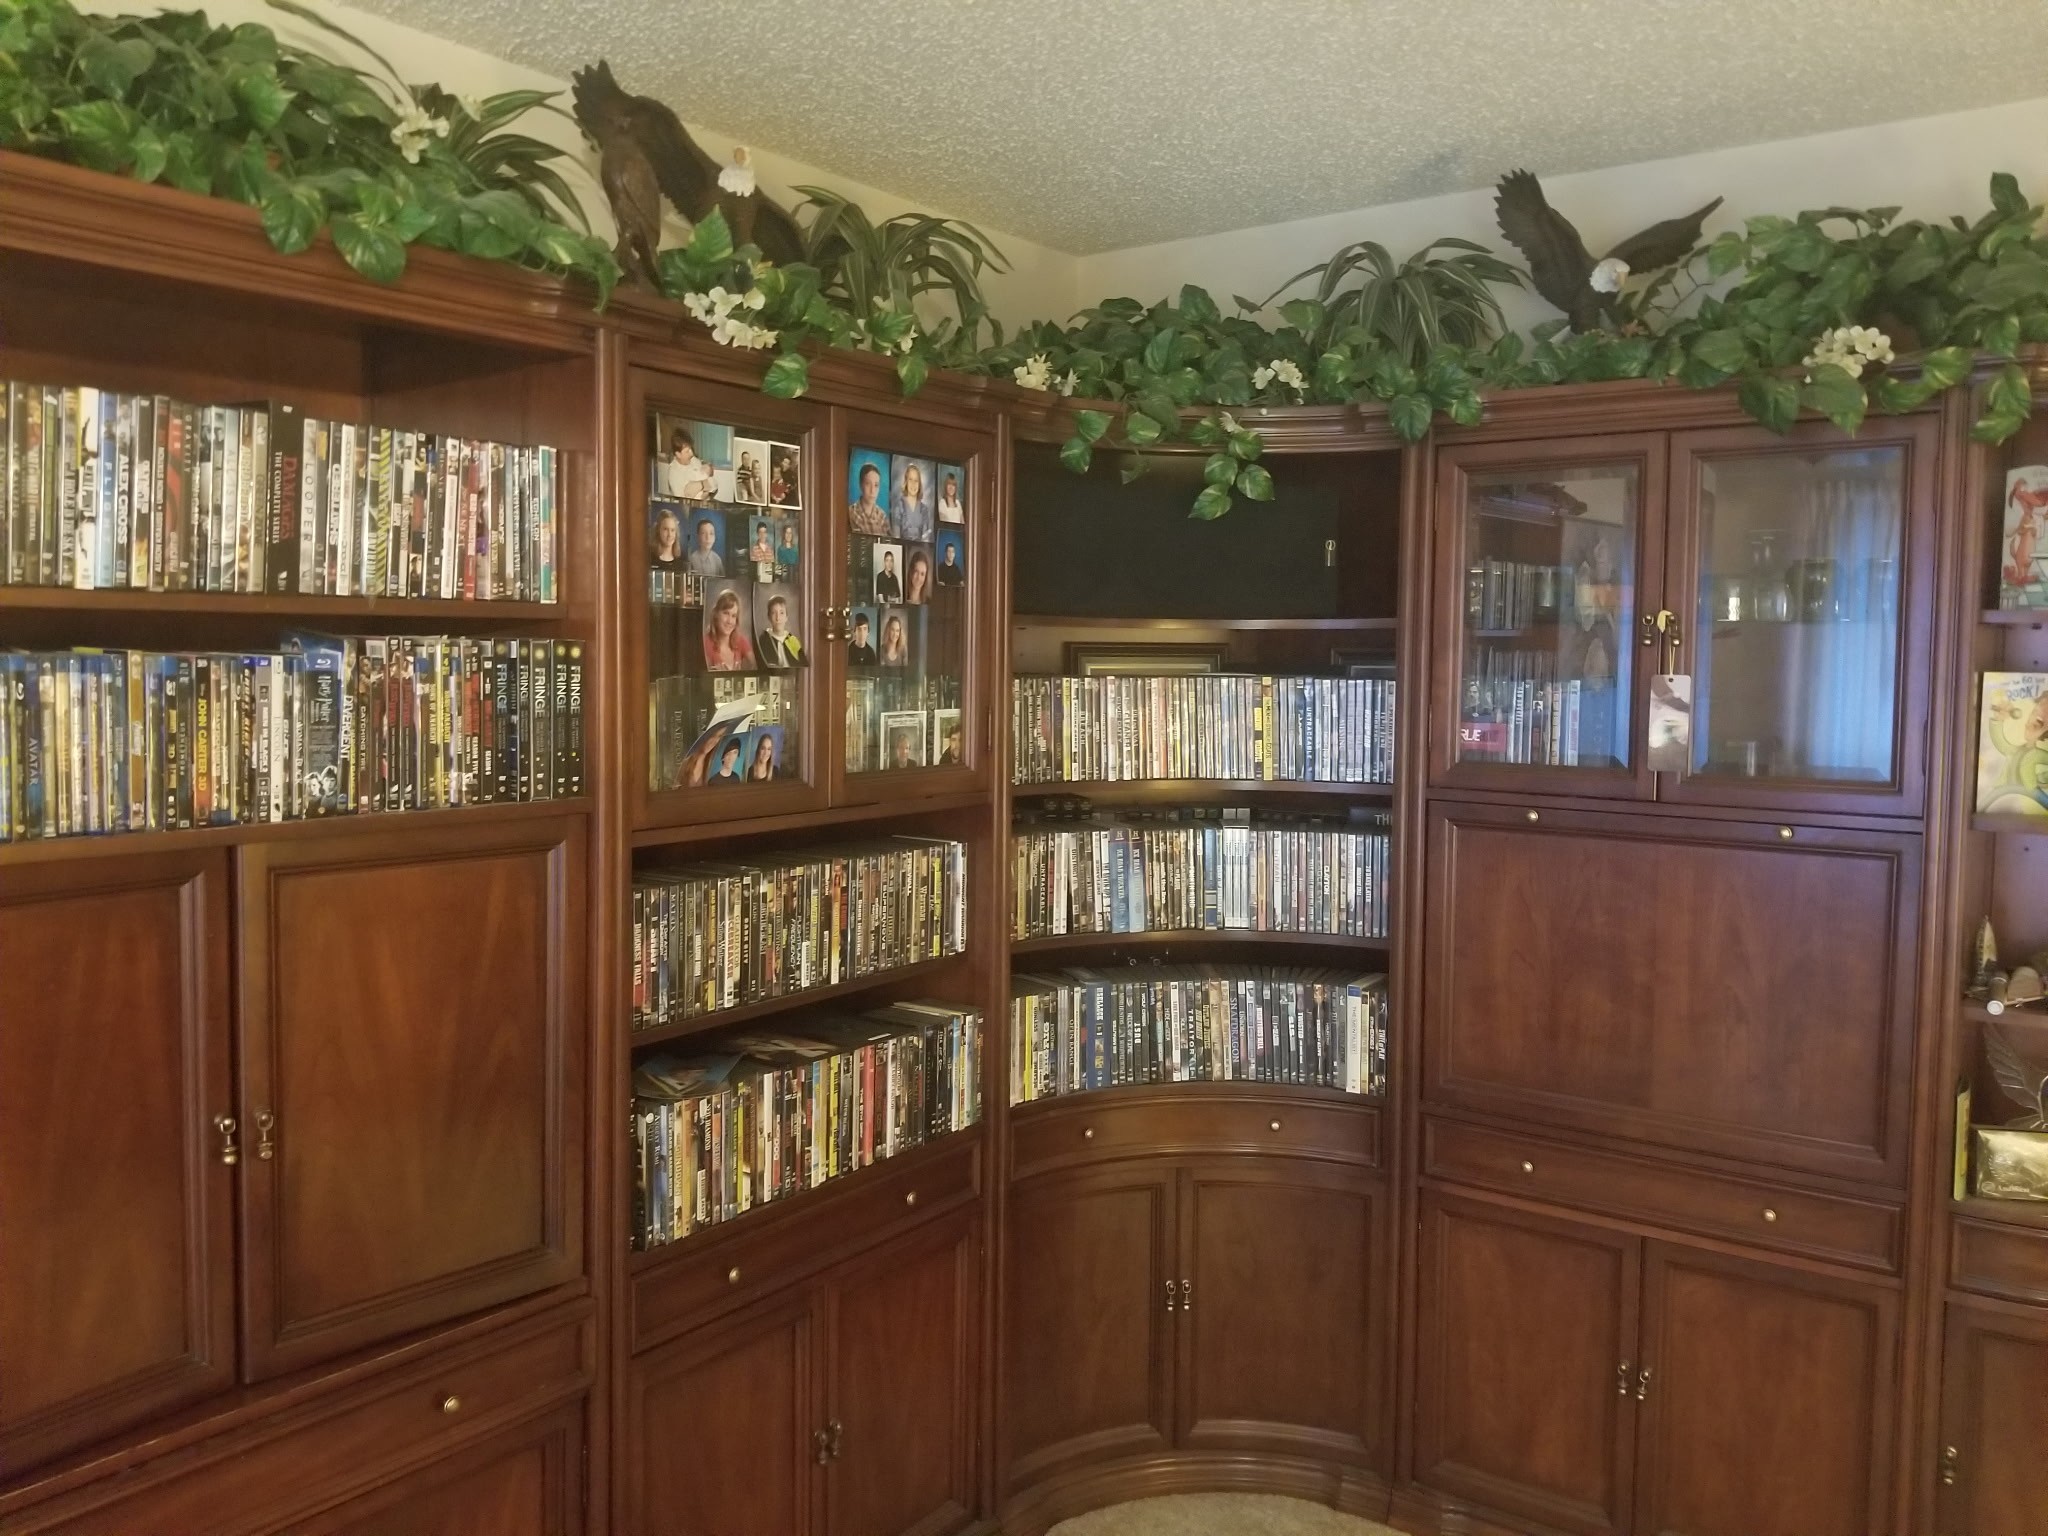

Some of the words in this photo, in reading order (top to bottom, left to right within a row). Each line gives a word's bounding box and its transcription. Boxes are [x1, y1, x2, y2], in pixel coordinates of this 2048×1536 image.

[156, 447, 165, 479] STATION
[184, 414, 193, 473] GRAVITY
[274, 452, 283, 467] THE
[119, 453, 129, 491] ALEX
[156, 480, 165, 504] UNION
[273, 470, 282, 513] COMPLETE
[103, 461, 113, 543] FLIGHT
[256, 474, 266, 513] GREEN
[281, 456, 299, 540] DAMAGES
[304, 463, 315, 542] LOOPER
[117, 495, 129, 544] CROSS
[272, 518, 281, 544] SERIES
[63, 537, 74, 558] SKY
[155, 544, 164, 572] ALISON
[317, 675, 331, 698] Harry
[496, 664, 508, 715] FRINGE
[520, 665, 530, 707] FRINGE
[535, 667, 547, 718] FRINGE
[556, 664, 567, 714] FRINGE
[570, 665, 581, 714] FRINGE
[198, 698, 208, 727] JOHN
[315, 698, 333, 723] Potter
[341, 695, 354, 762] DIVERGENT
[443, 712, 451, 744] ANARCHY
[198, 730, 207, 773] CARTER
[273, 716, 282, 763] LINCOLN
[1461, 728, 1481, 742] RUE
[28, 737, 39, 786] AVATAR
[295, 757, 304, 786] BLACK
[198, 776, 207, 791] 3D
[634, 923, 642, 963] DARKNESS
[651, 928, 659, 973] SHAFT
[634, 964, 642, 986] FALLS
[1230, 997, 1240, 1063] SNAPDRAGON
